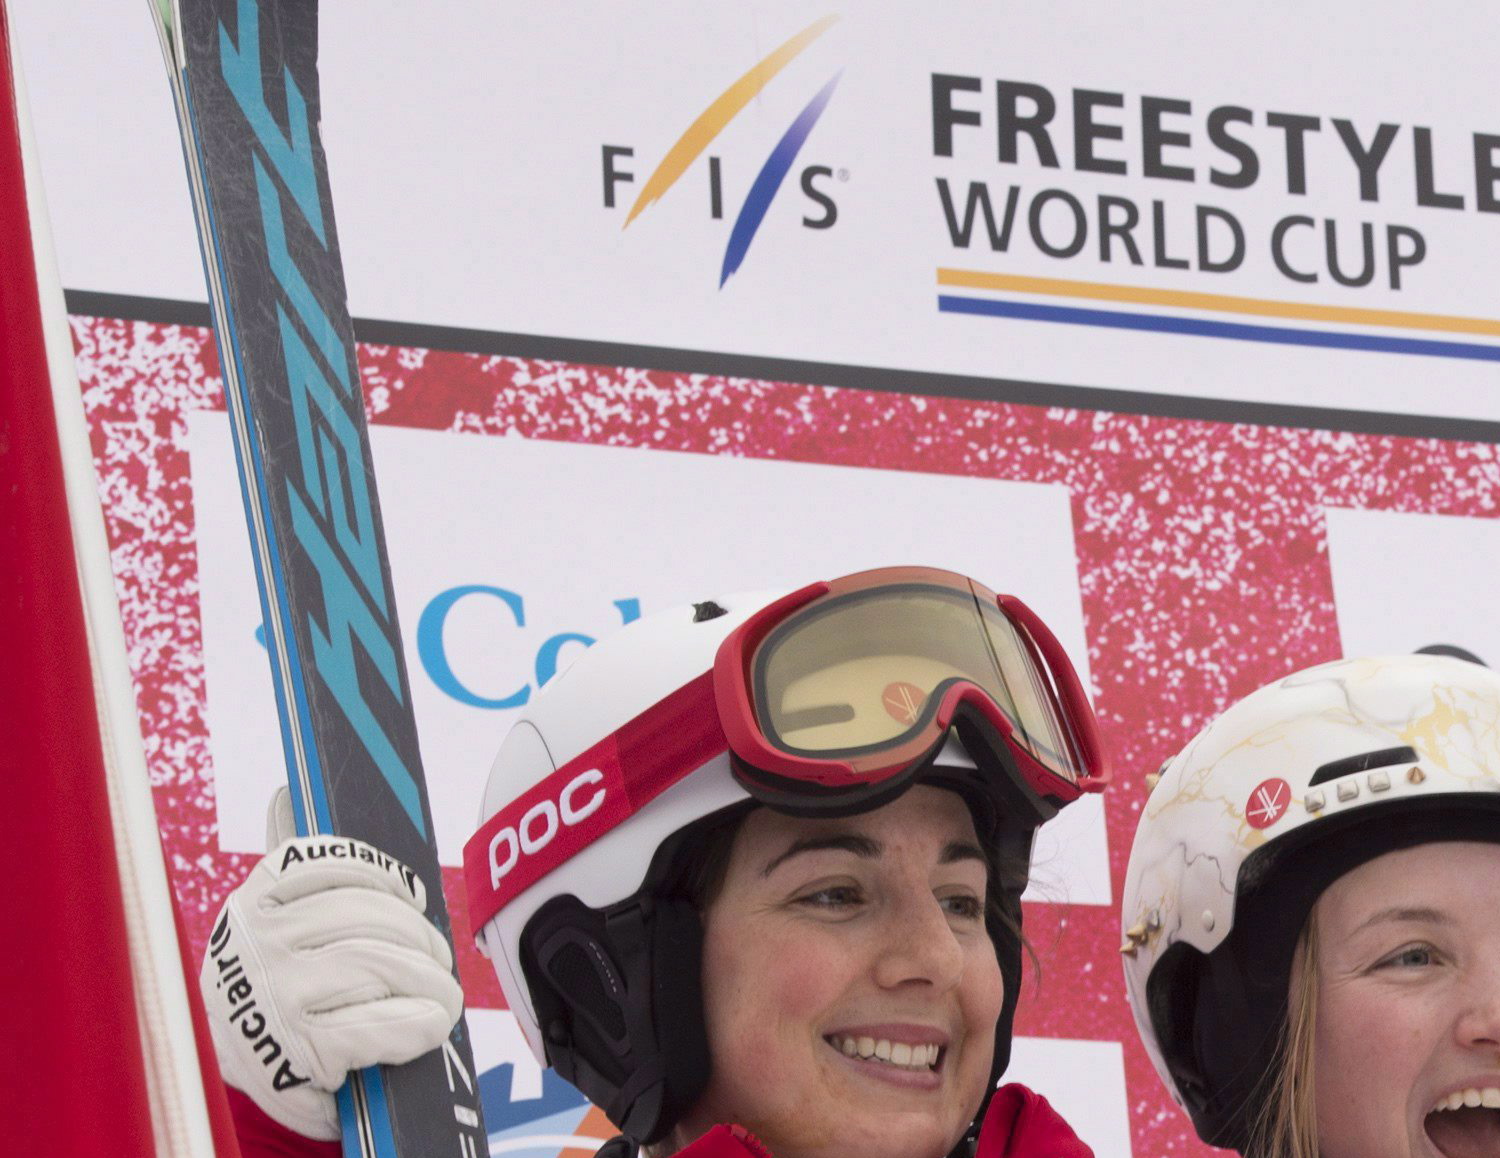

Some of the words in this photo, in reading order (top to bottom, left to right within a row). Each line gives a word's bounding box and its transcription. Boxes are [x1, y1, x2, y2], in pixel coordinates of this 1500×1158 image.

[602, 145, 839, 230] FIS
[937, 178, 1246, 274] WORLD
[1269, 214, 1427, 290] CUP
[280, 841, 401, 877] Auclair
[215, 951, 311, 1092] Auclair
